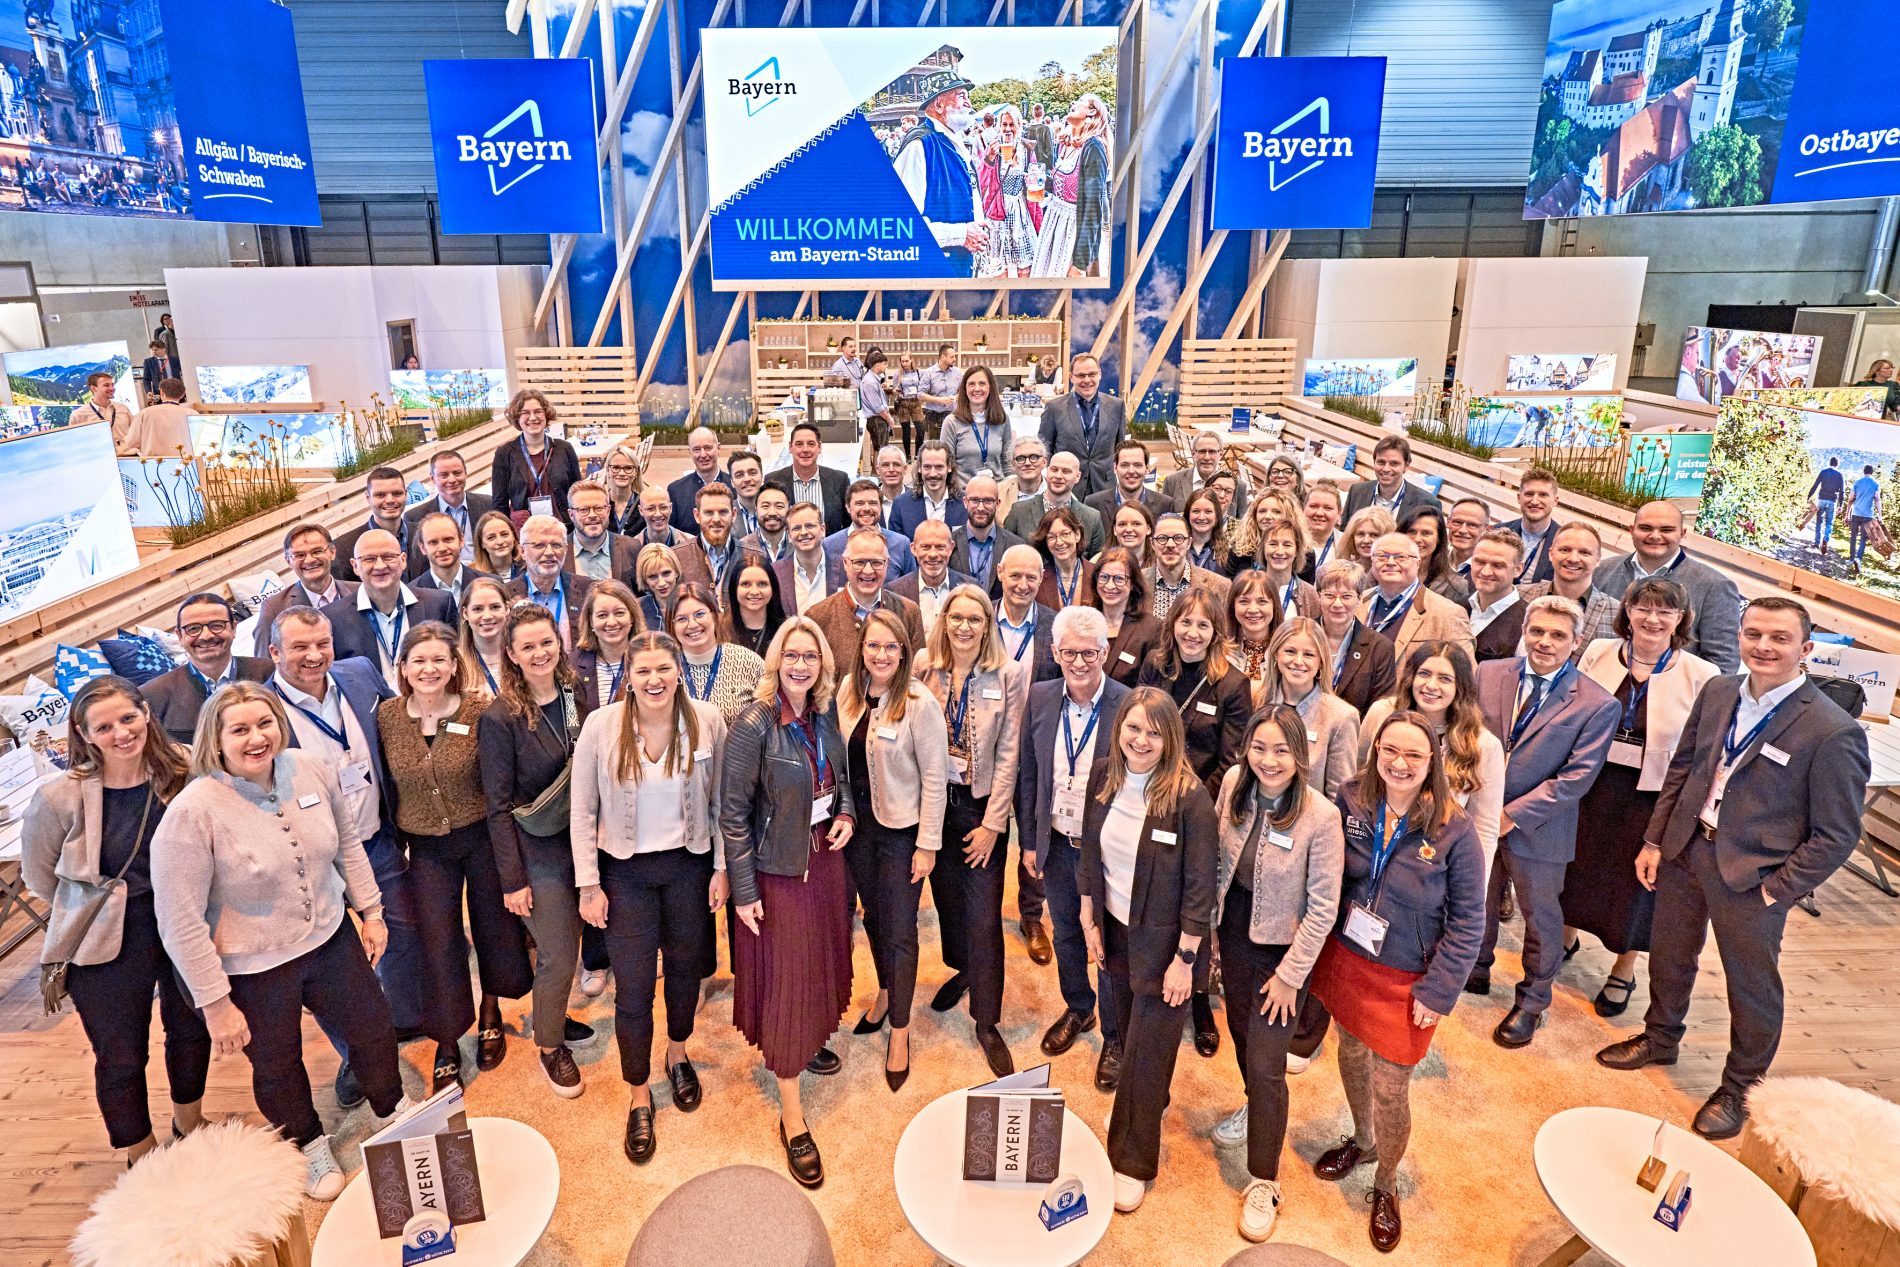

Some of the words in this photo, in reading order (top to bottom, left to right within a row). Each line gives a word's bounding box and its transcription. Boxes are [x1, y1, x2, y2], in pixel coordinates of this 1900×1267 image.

[728, 79, 797, 99] Bayern
[195, 137, 238, 162] Allgäu
[240, 144, 245, 162] /
[247, 145, 307, 170] Bayerisch-
[457, 135, 572, 168] Bayern
[1242, 131, 1353, 164] Bayern
[1800, 127, 1900, 156] Ostbaye
[199, 164, 266, 189] Schwaben
[735, 217, 913, 241] WILLKOMMEN
[770, 250, 797, 262] am
[800, 246, 920, 266] Bayern-Stand!
[129, 294, 146, 302] SWISS
[1847, 674, 1886, 687] Bayern
[21, 697, 67, 724] Bayer
[1005, 1115, 1021, 1171] BAYERN
[414, 1157, 437, 1209] AYERN
